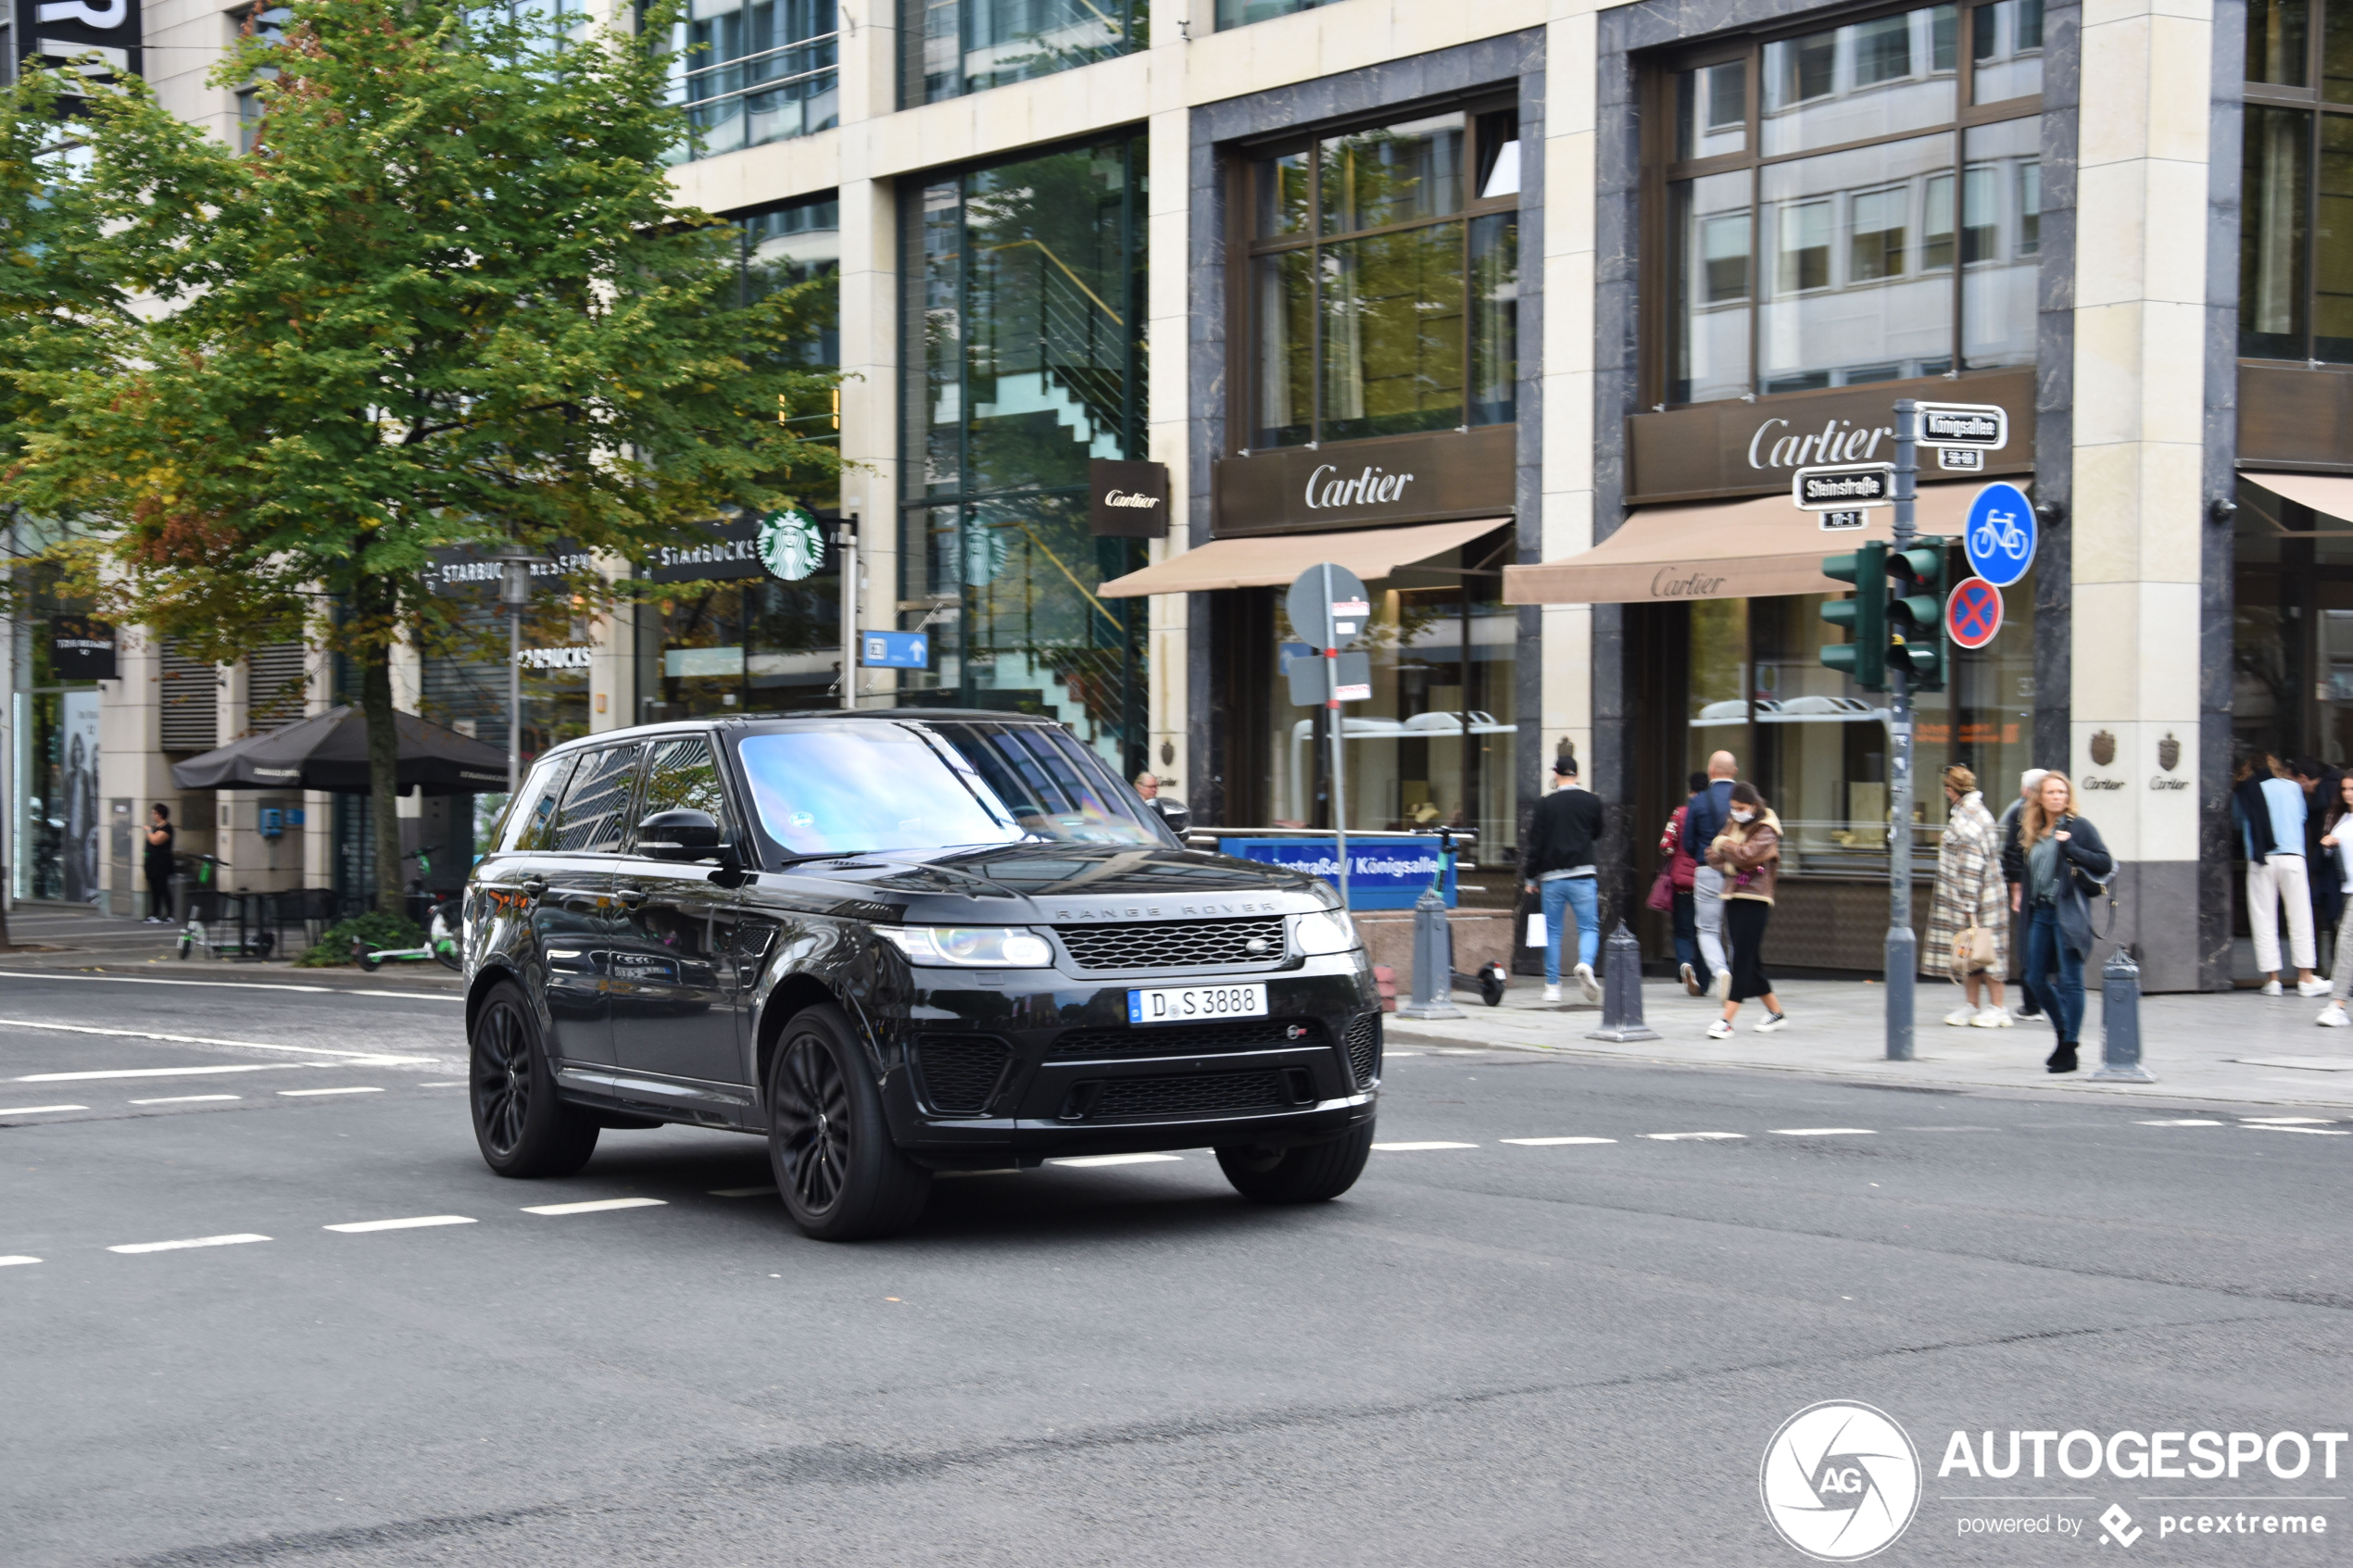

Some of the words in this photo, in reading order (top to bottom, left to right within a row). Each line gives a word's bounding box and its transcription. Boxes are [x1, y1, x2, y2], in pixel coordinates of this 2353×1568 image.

[1929, 415, 1995, 438] Königsallee
[1748, 418, 1894, 470] Cartier
[1305, 464, 1415, 508] Cartier
[1806, 476, 1881, 498] Steinstraße
[1104, 489, 1160, 508] Cartier
[442, 562, 504, 583] STARBUC
[1651, 566, 1727, 597] Cartier
[2082, 775, 2126, 791] Cartier
[2149, 775, 2190, 791] Cartier
[1356, 857, 1440, 878] Königsalle
[1055, 907, 1162, 920] RANGE
[1183, 902, 1276, 916] ROVER
[1151, 993, 1165, 1017] D
